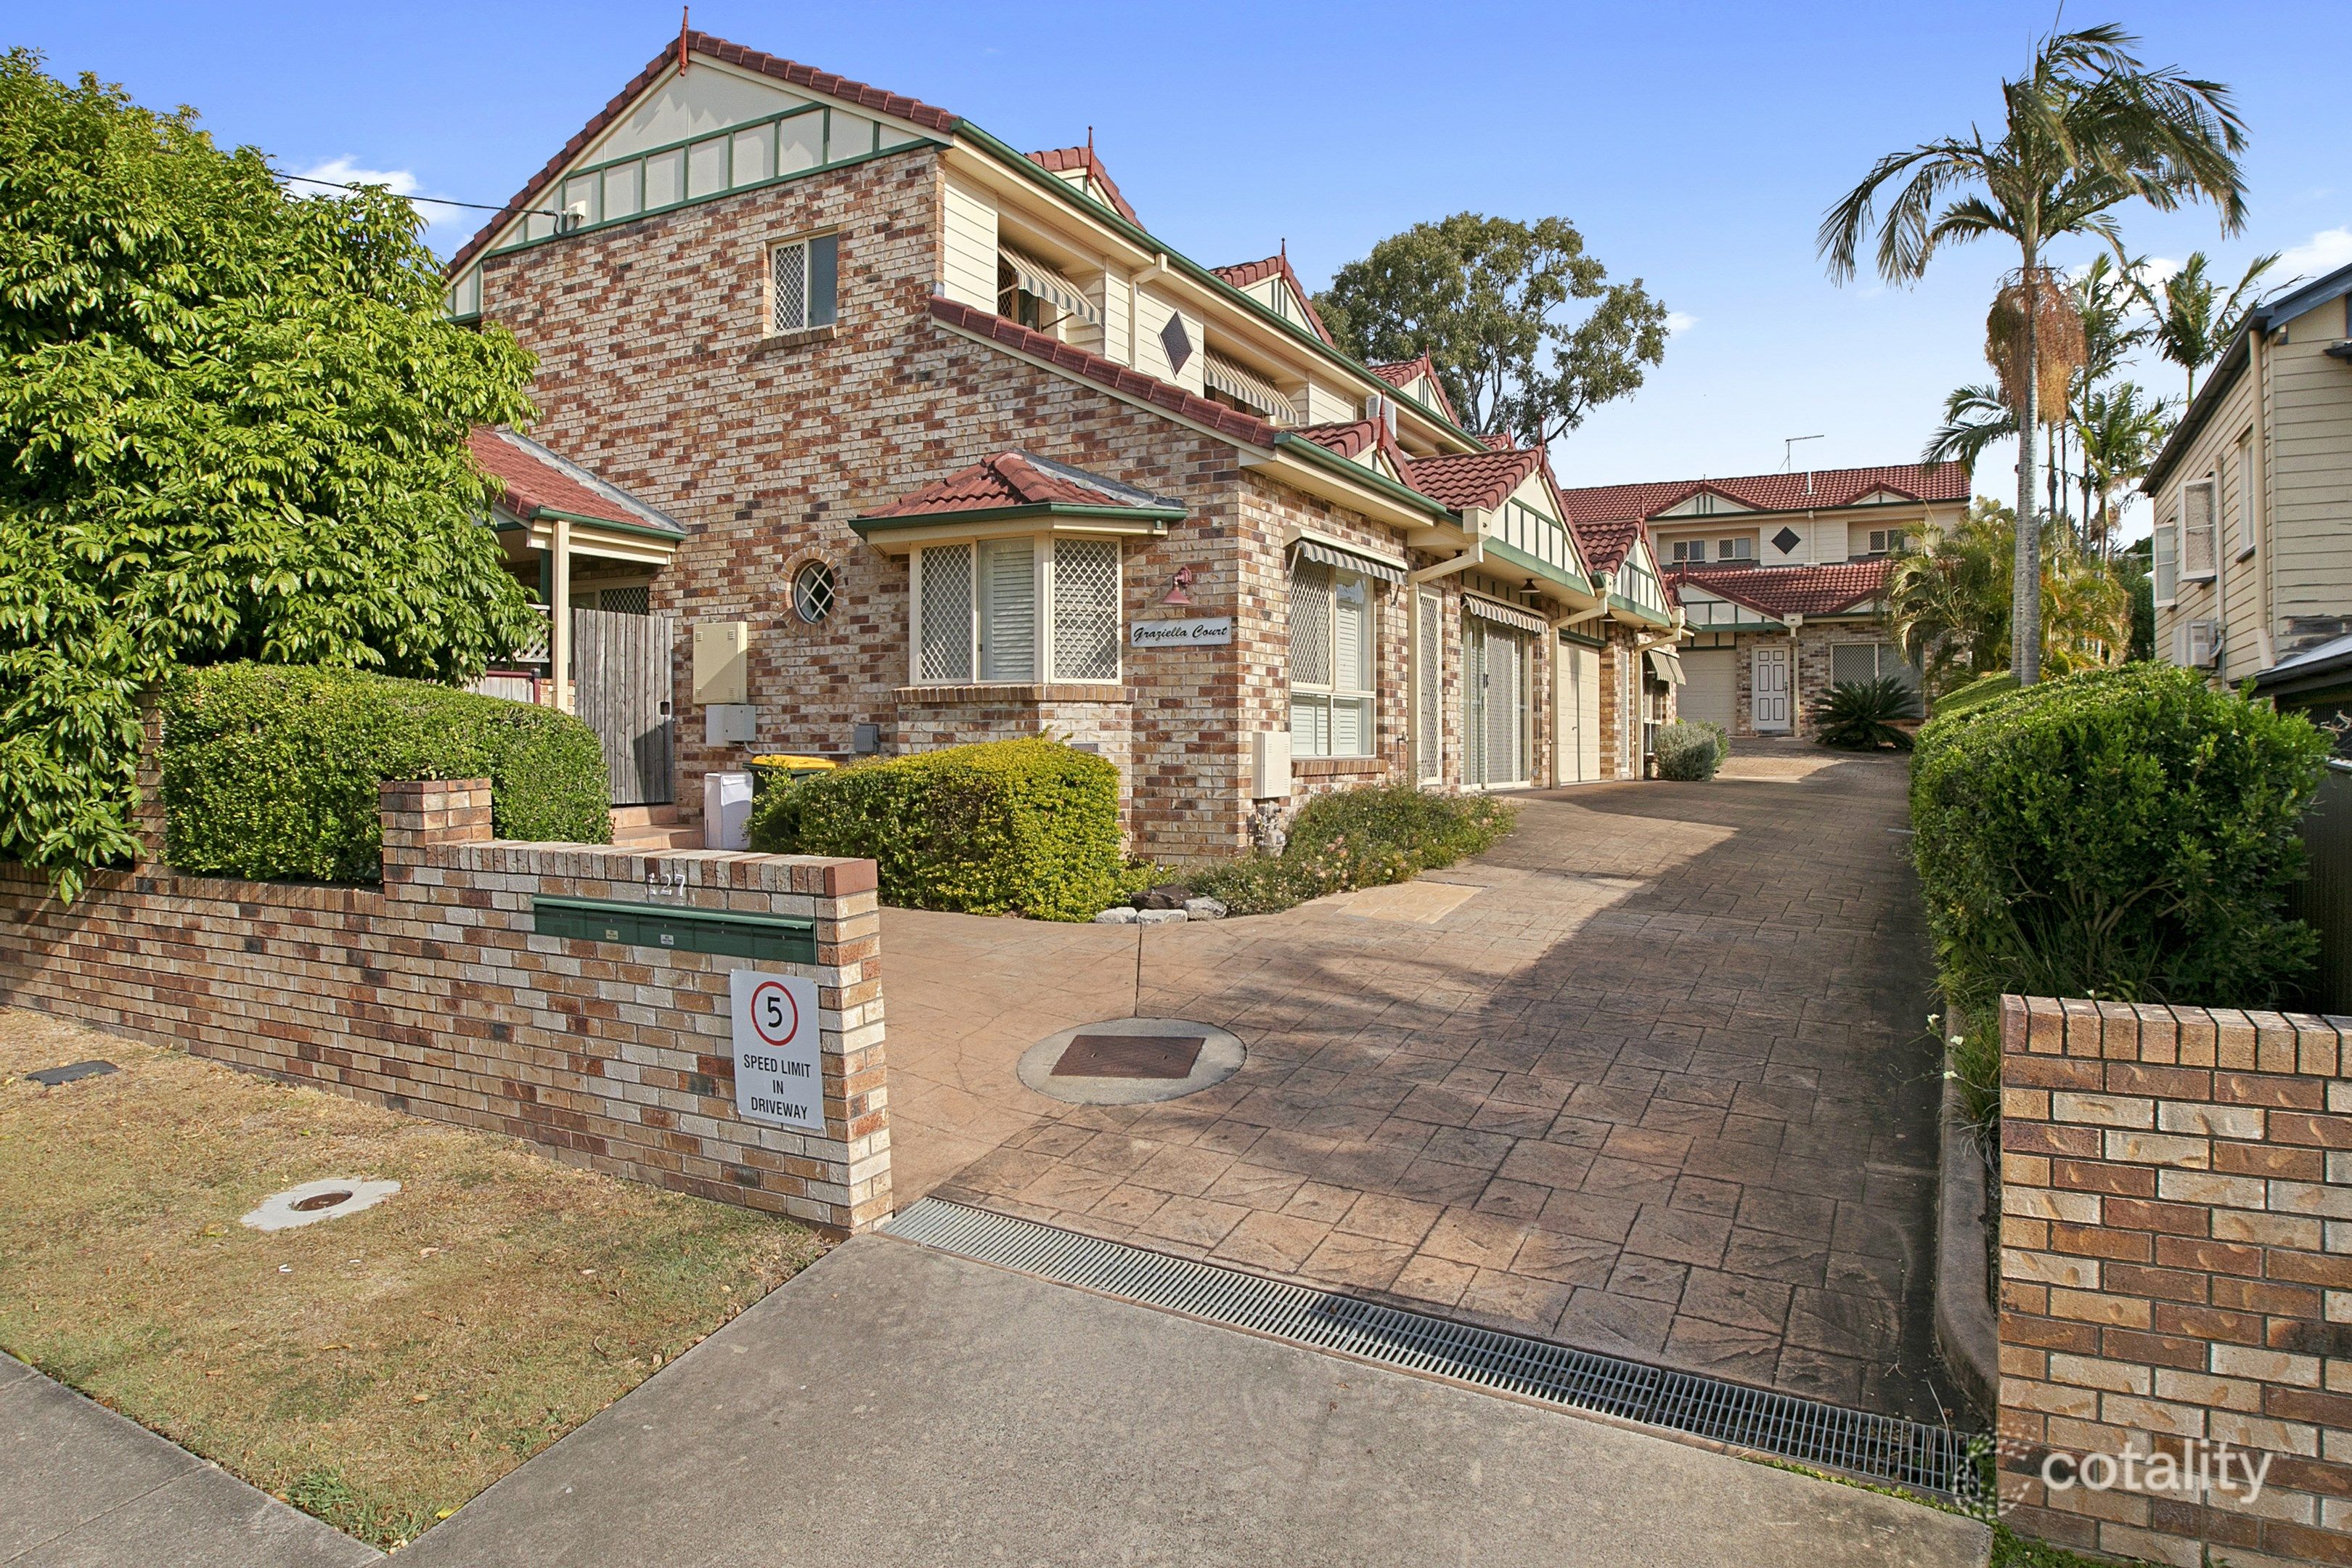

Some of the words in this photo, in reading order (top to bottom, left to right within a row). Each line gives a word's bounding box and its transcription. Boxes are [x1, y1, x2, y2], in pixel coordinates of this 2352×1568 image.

[1133, 626, 1188, 642] Graziella
[1192, 624, 1228, 638] Court
[767, 996, 783, 1028] 5
[743, 1054, 777, 1072] SPEED
[781, 1061, 811, 1078] LIMIT
[772, 1079, 783, 1095] IN
[751, 1097, 808, 1119] DRIVEWAY
